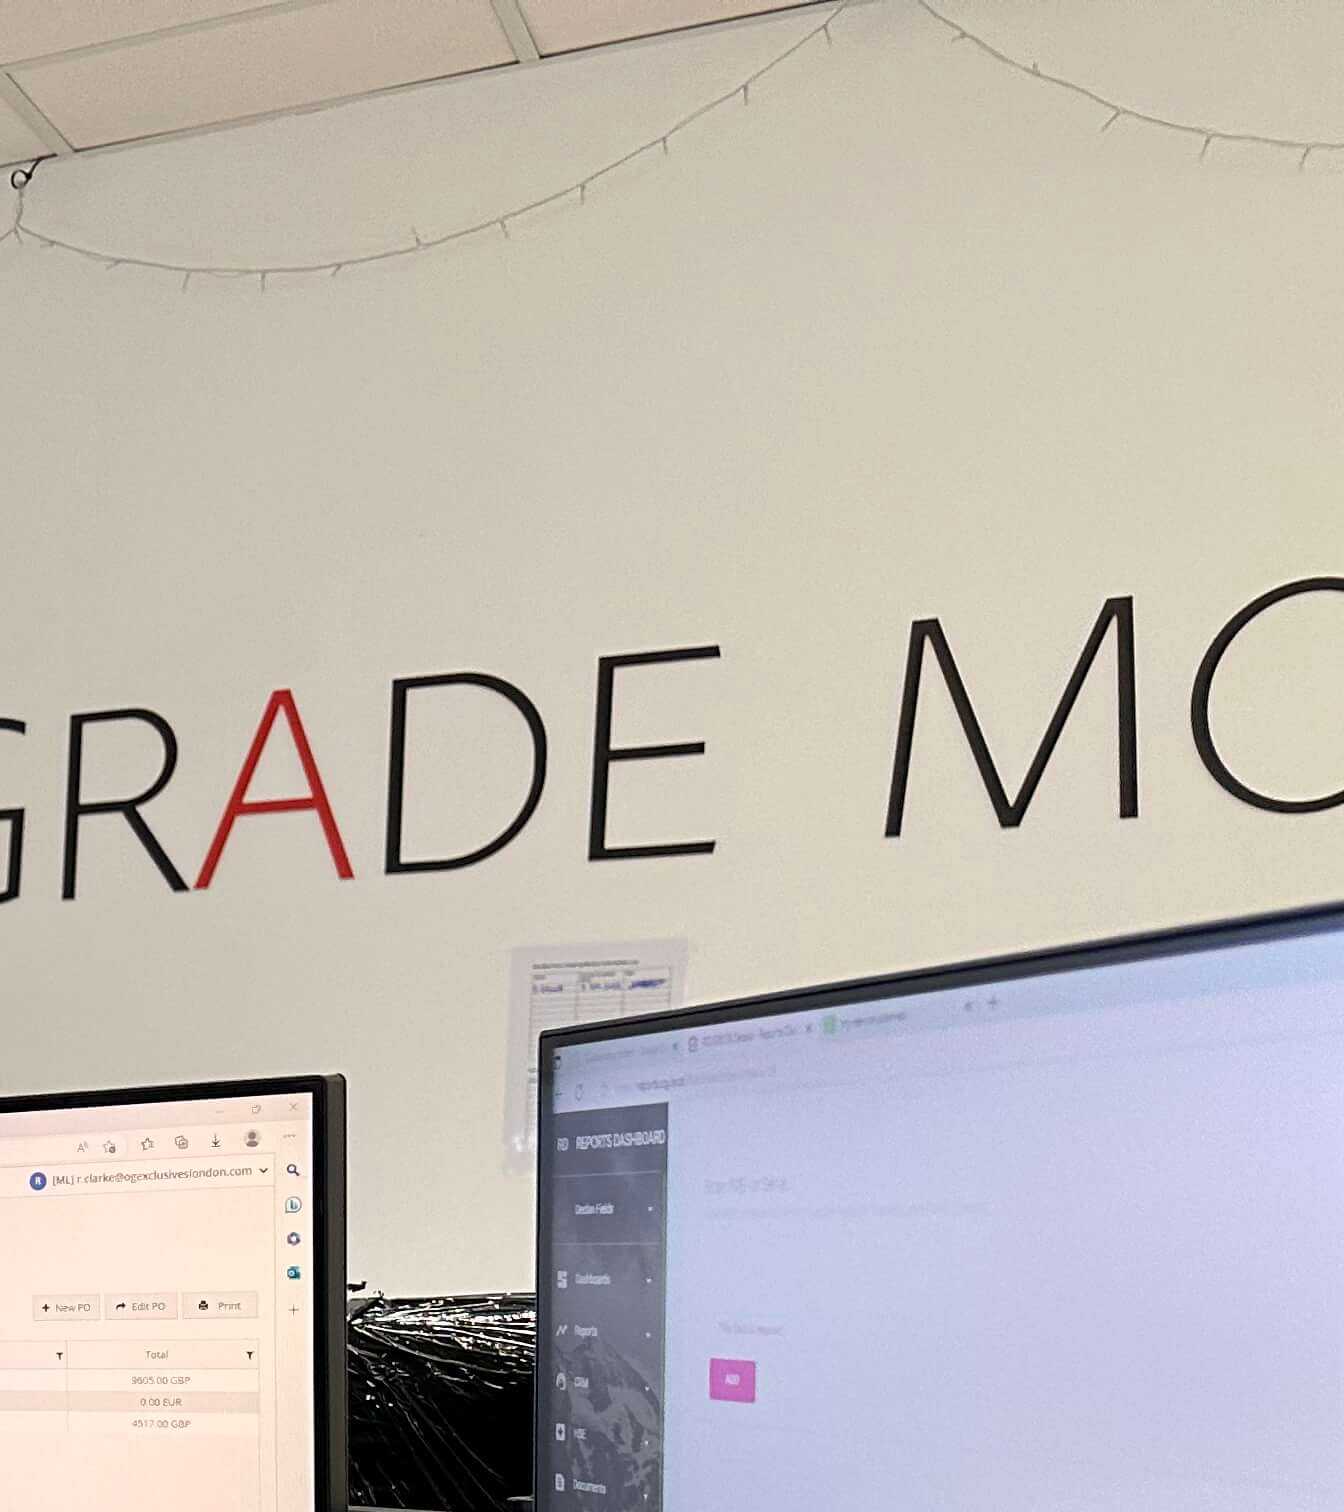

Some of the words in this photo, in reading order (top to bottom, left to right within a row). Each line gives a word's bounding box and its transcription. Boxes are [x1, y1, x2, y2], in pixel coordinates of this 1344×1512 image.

[575, 1132, 612, 1150] REPORTS
[612, 1130, 665, 1148] DASHBOARD
[55, 1302, 75, 1312] New
[77, 1302, 91, 1312] PO
[132, 1302, 149, 1311] Edit
[151, 1302, 165, 1311] PO
[218, 1301, 241, 1311] Print
[146, 1350, 169, 1360] Total
[170, 1375, 190, 1385] GBP
[162, 1398, 182, 1408] EUR
[170, 1419, 191, 1429] GBP
